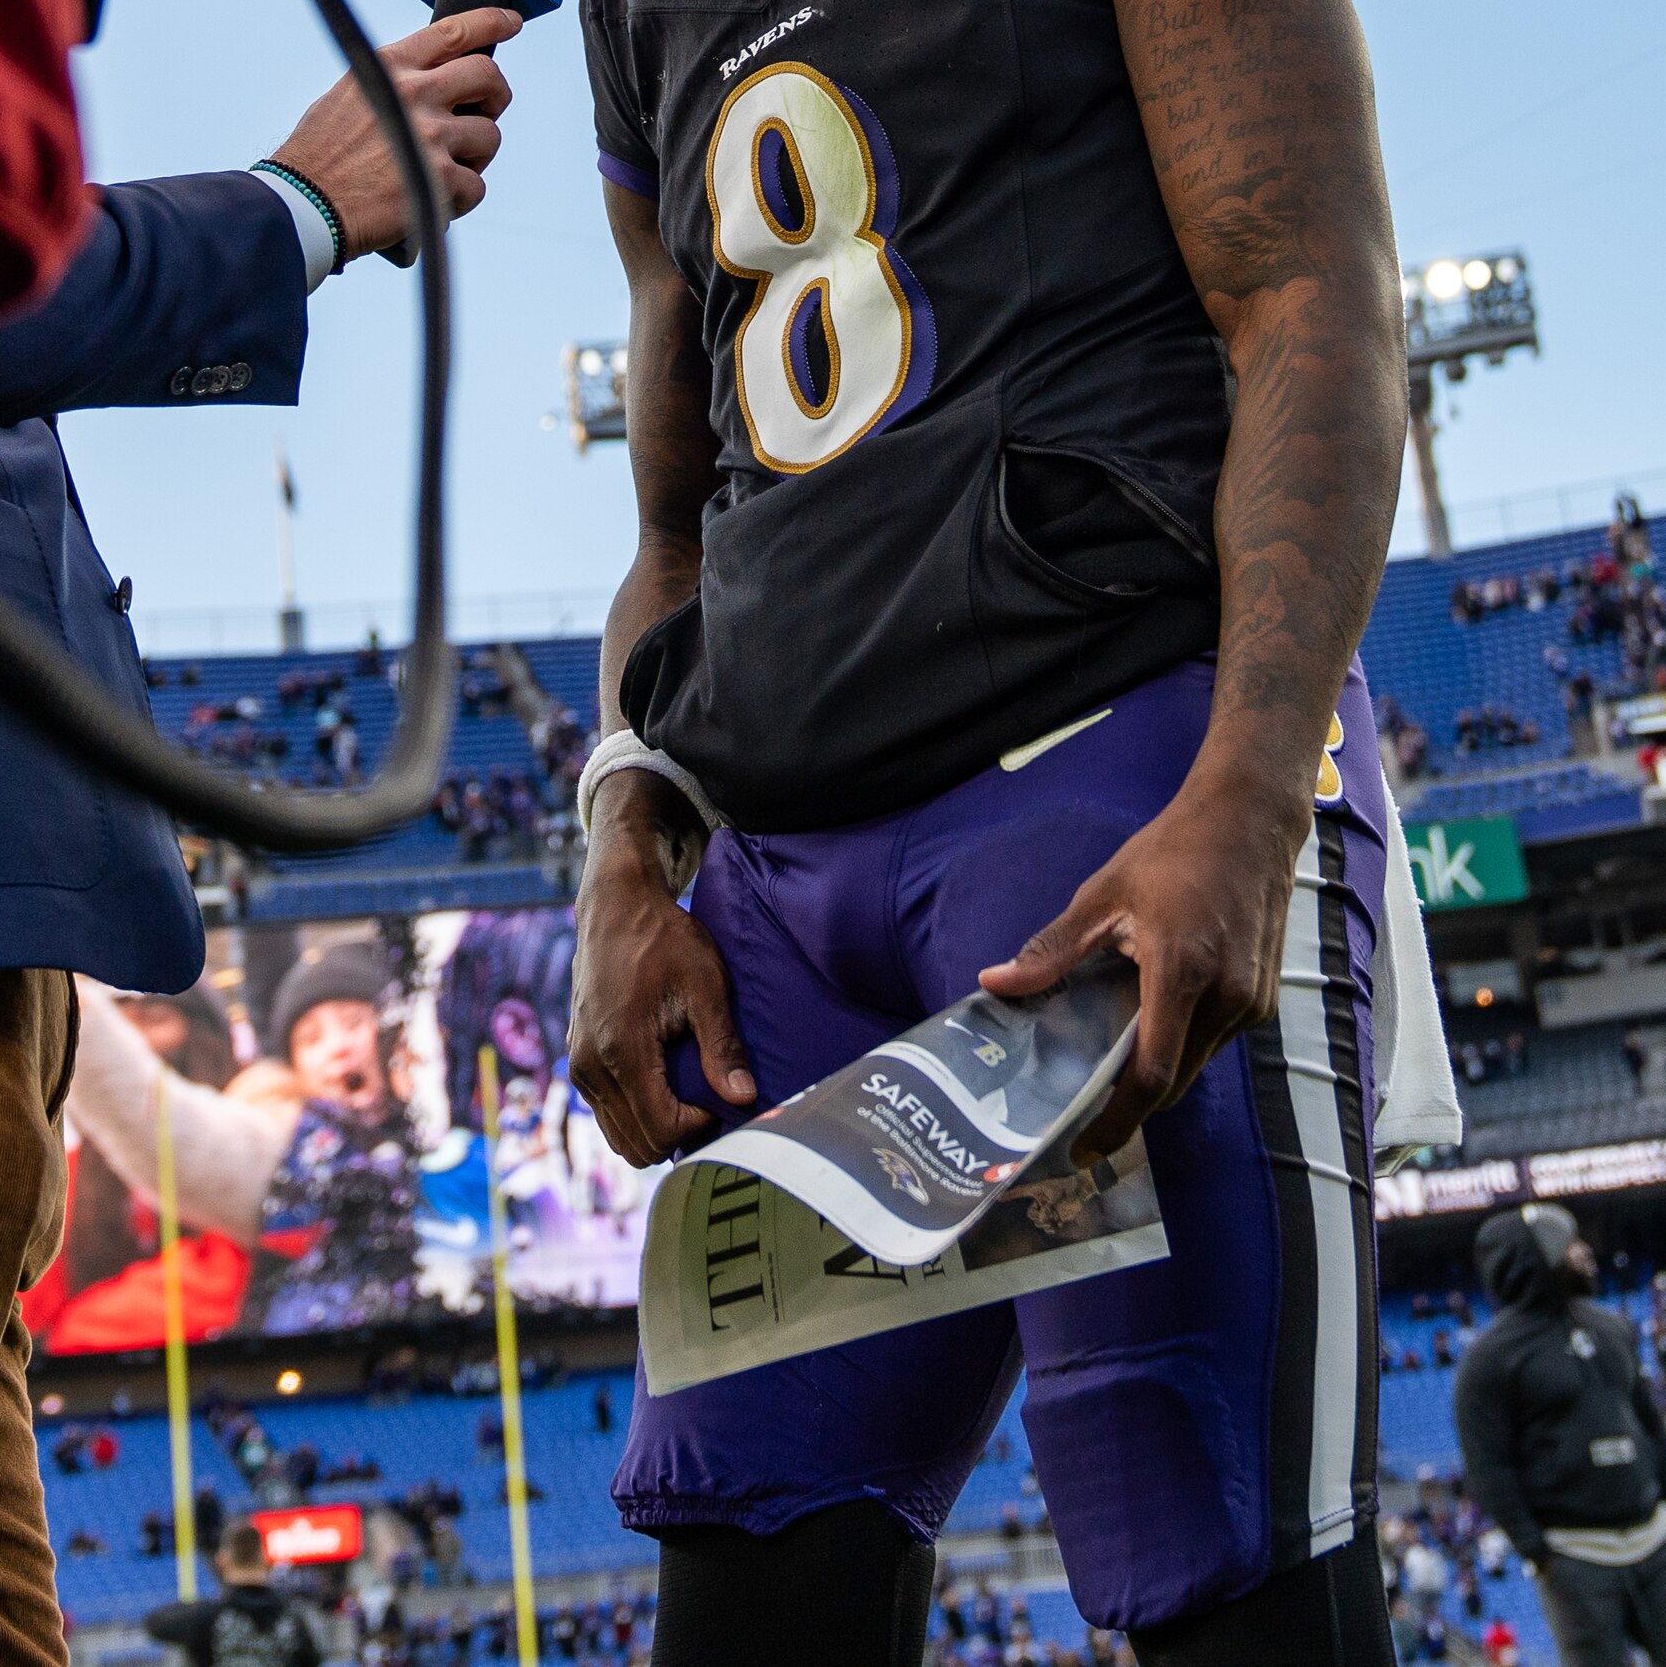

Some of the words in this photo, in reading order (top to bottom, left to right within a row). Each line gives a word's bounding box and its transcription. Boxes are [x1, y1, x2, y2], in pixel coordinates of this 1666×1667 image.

[719, 6, 813, 81] RAVENS
[705, 60, 921, 475] 8
[1408, 823, 1485, 904] nk
[856, 1106, 873, 1118] of
[870, 1114, 891, 1133] the
[889, 1129, 941, 1181] Baltimore
[939, 1177, 984, 1197] Ravens
[861, 1073, 990, 1175] SAFEWAY
[875, 1103, 914, 1138] Official
[913, 1136, 984, 1188] Supermarket
